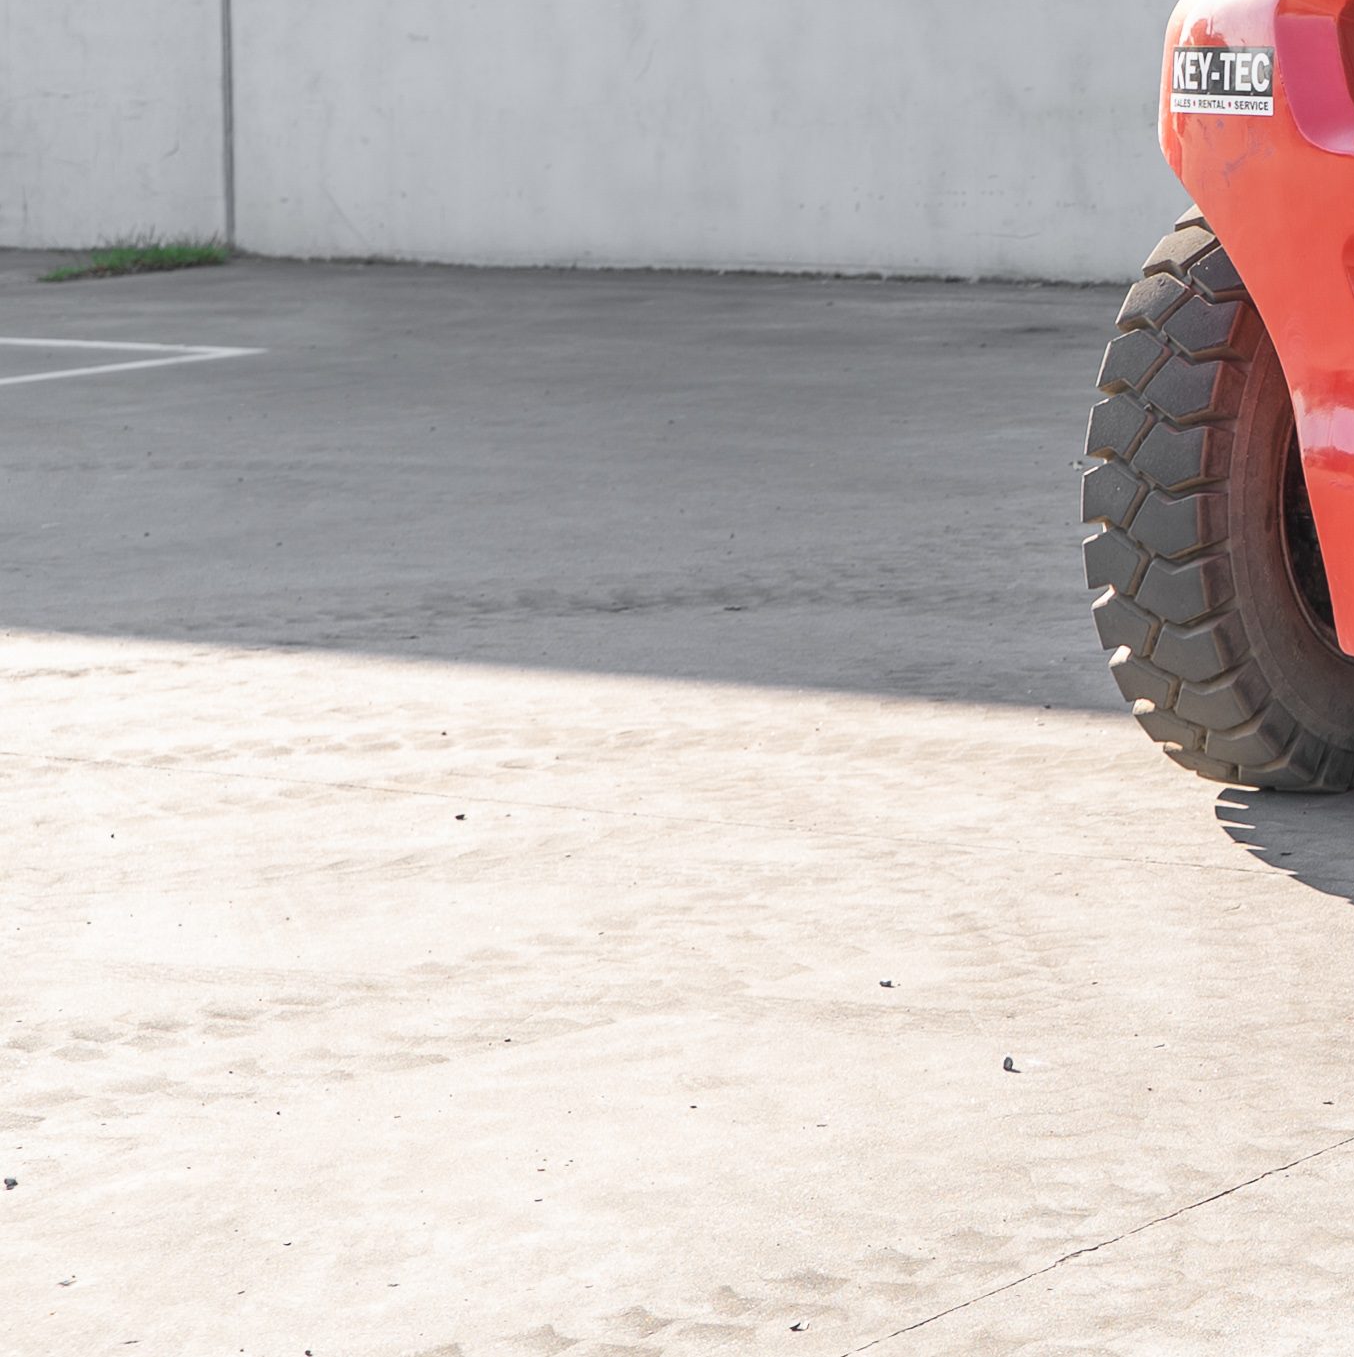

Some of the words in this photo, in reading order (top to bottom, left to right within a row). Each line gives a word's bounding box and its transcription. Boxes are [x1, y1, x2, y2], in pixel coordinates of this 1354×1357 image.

[1172, 51, 1271, 93] KEY-TEC
[1198, 99, 1226, 110] RENTAL
[1234, 100, 1269, 111] SERVICE
